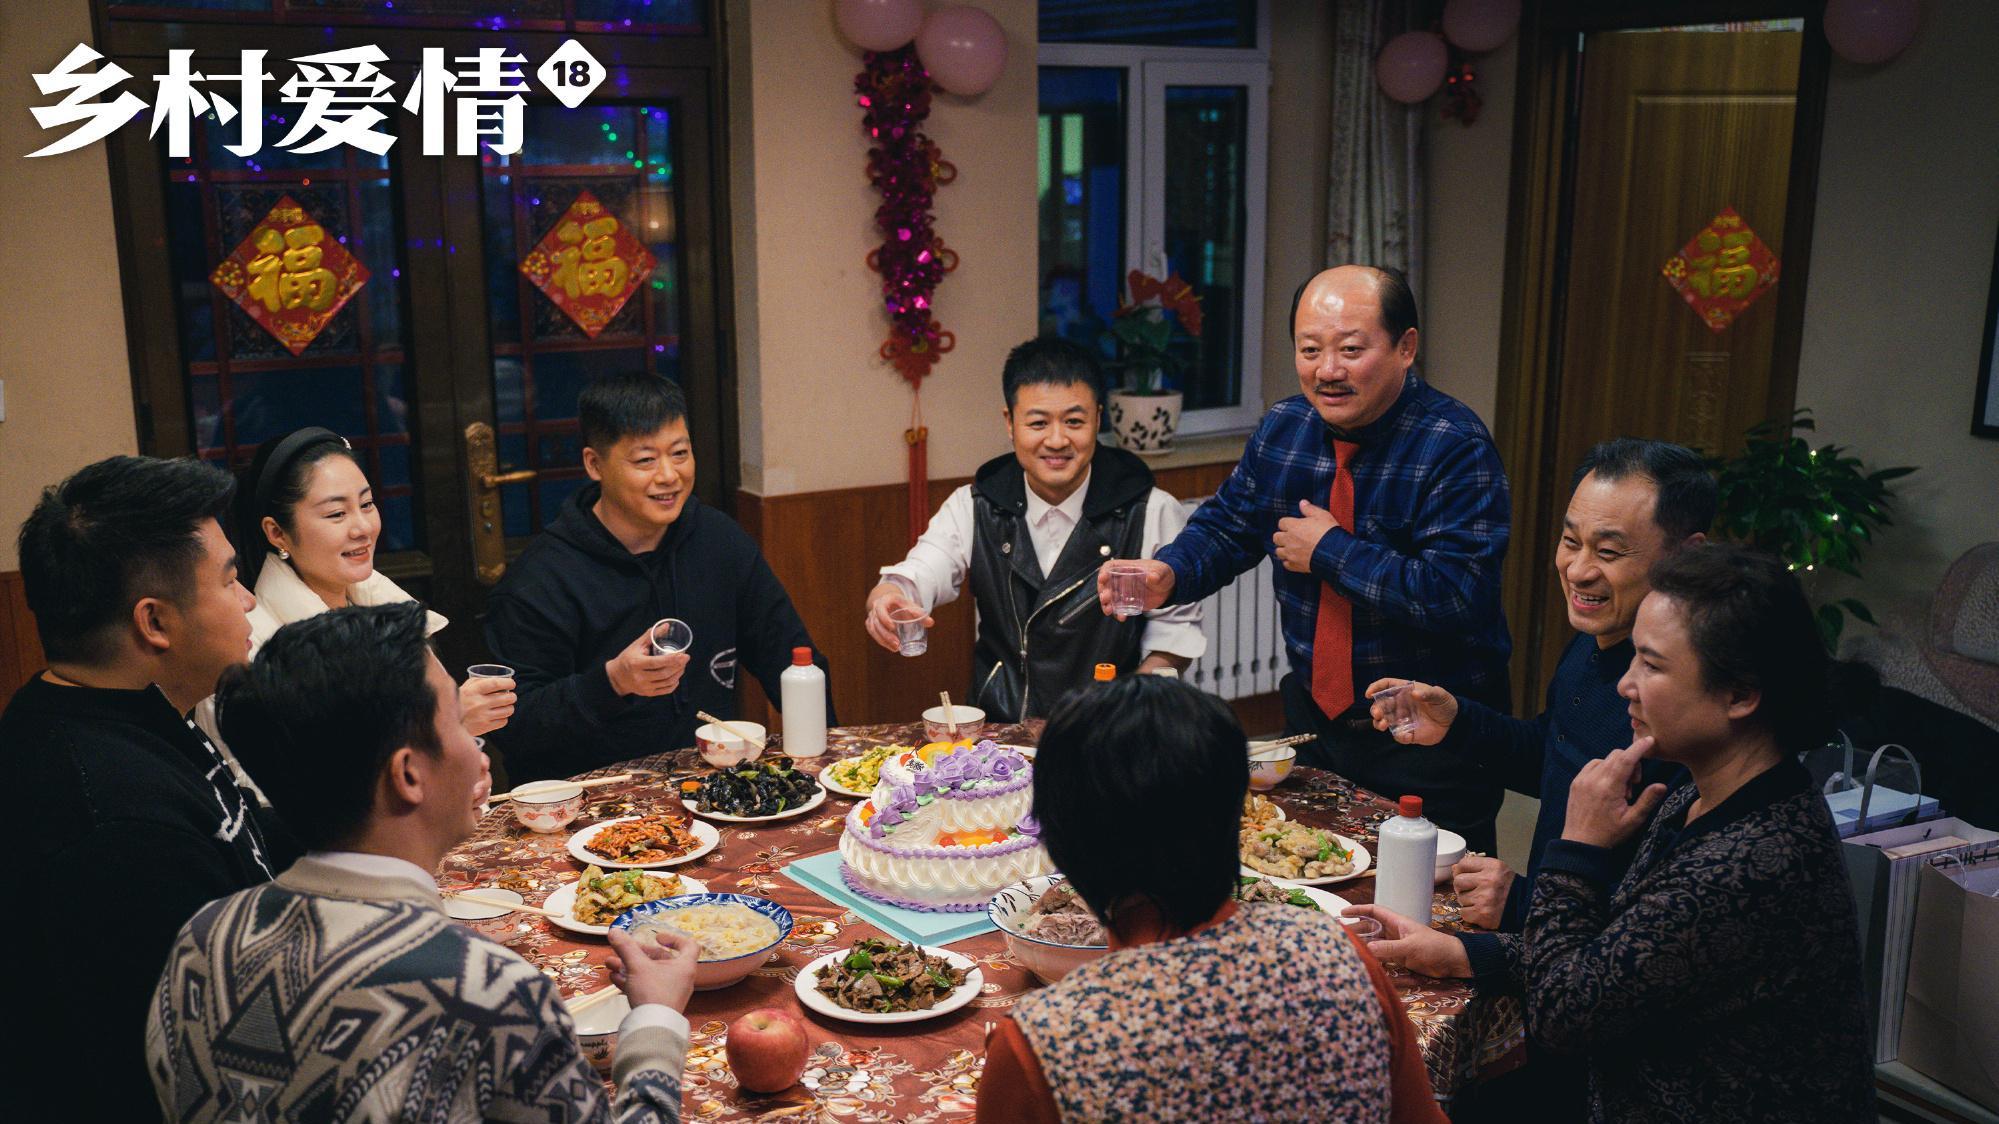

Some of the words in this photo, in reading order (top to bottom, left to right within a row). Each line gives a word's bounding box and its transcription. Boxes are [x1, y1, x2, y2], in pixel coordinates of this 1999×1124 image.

[246, 223, 338, 314] 福
[550, 215, 629, 300] 福
[1688, 228, 1758, 299] 福
